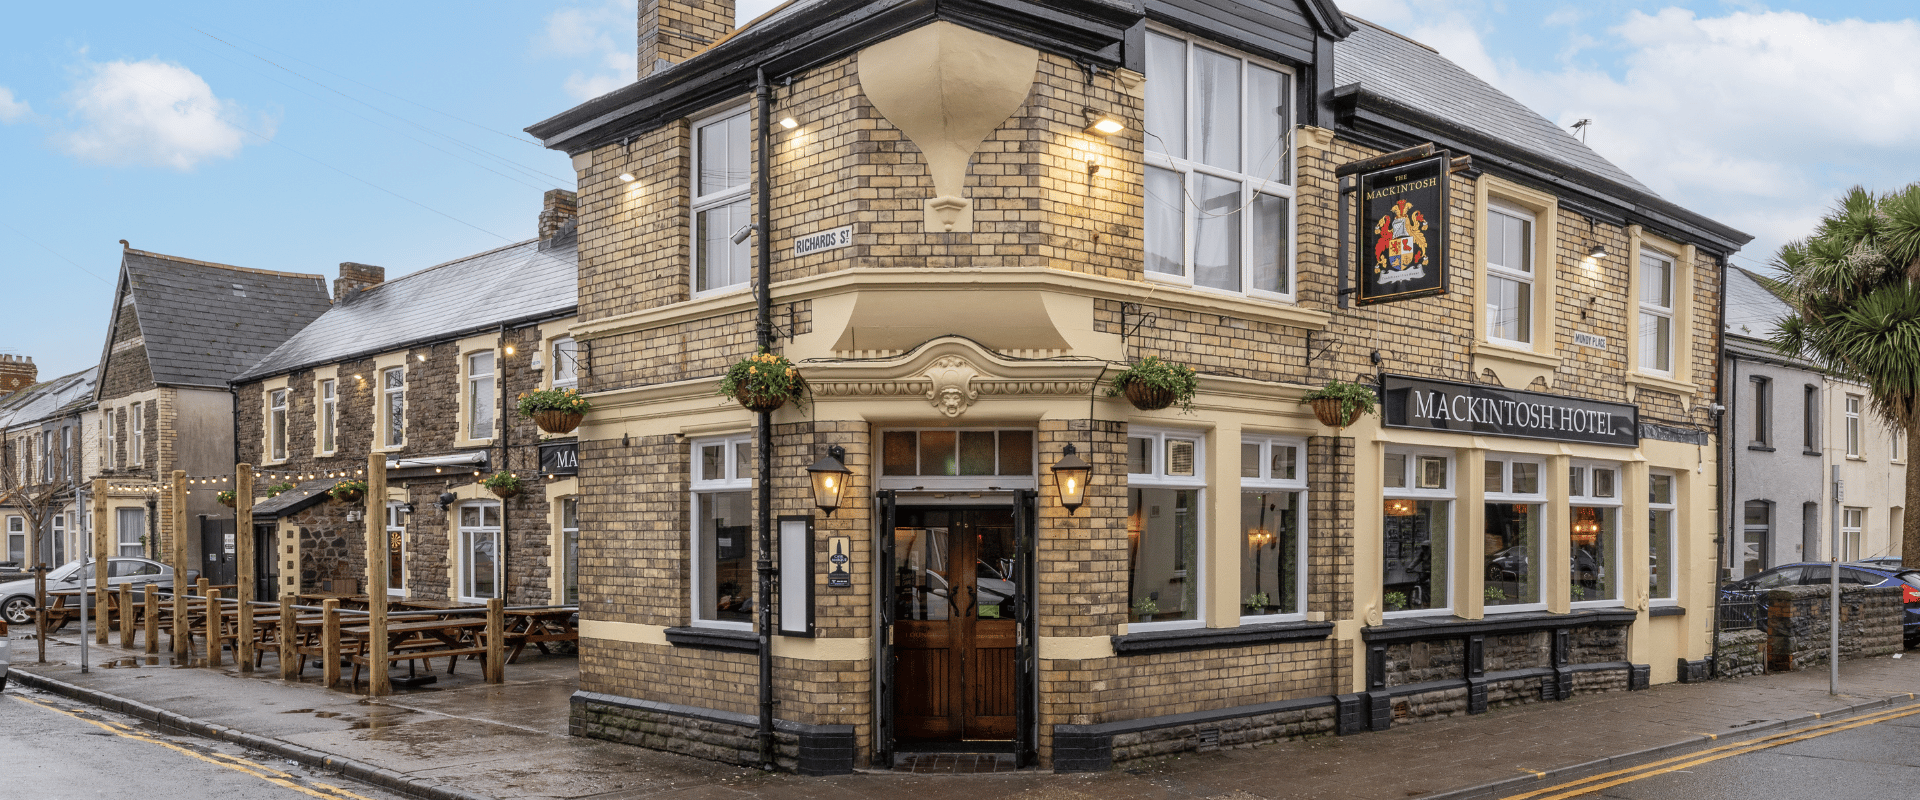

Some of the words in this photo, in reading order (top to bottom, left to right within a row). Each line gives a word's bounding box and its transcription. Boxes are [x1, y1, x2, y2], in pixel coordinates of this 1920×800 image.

[1366, 177, 1437, 200] MACKINTOSH
[1395, 174, 1408, 182] THE
[796, 232, 836, 254] RICHARDS
[1592, 336, 1606, 349] PLACE
[1414, 390, 1554, 430] MACKINTOSH
[1559, 406, 1617, 436] HOTEL
